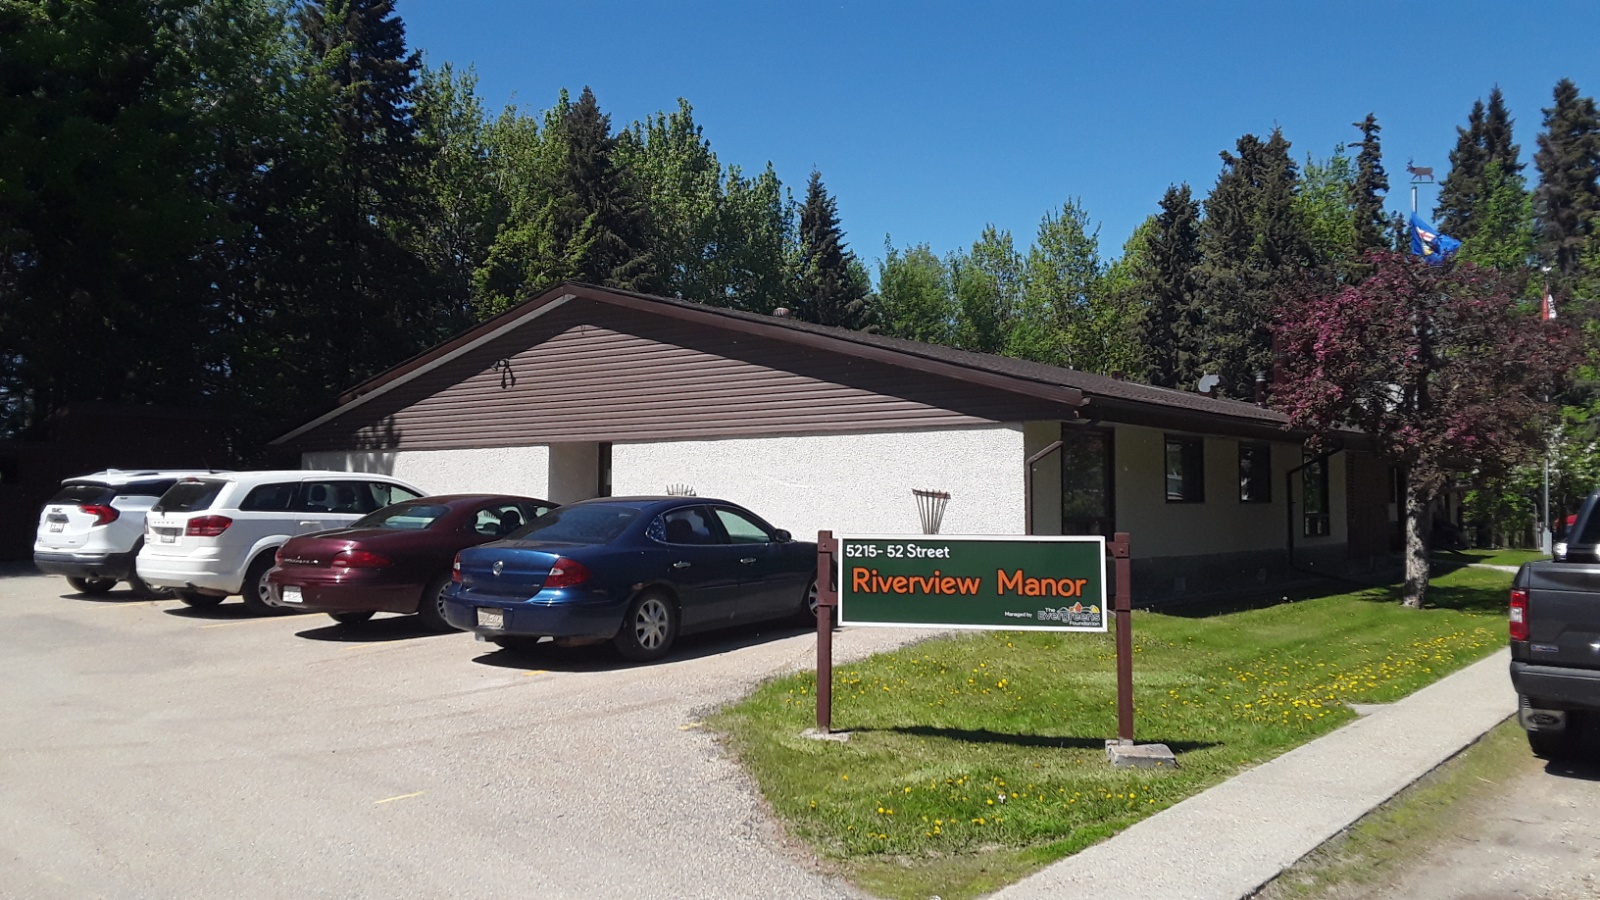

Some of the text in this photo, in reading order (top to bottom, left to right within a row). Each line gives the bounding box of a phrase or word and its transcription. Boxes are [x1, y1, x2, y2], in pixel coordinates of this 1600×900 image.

[886, 545, 904, 558] 52
[906, 543, 950, 559] Street
[852, 567, 1087, 597] Riverview Manor
[1037, 610, 1100, 623] Evergreens
